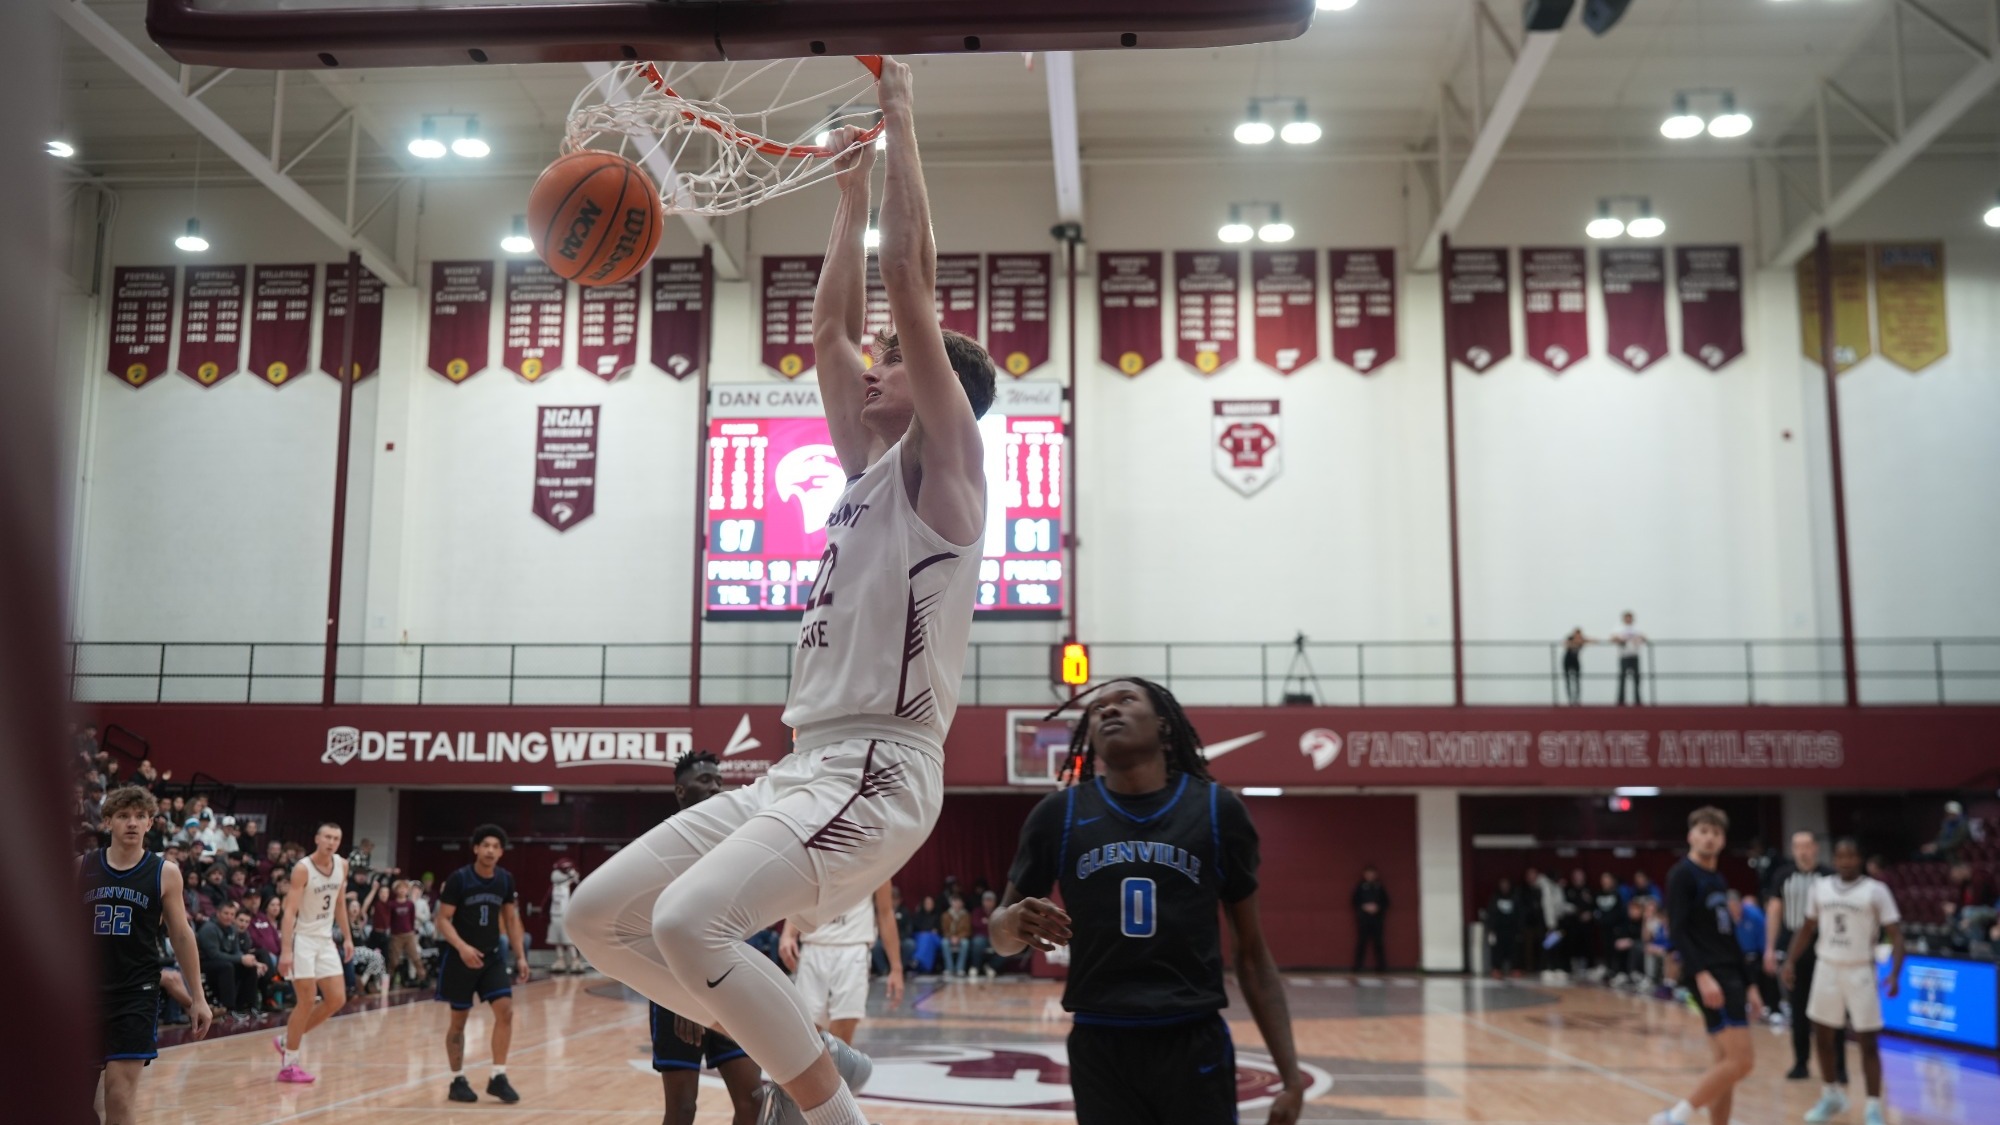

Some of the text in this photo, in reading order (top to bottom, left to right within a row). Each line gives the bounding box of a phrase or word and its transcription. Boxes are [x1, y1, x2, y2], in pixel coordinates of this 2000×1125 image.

[559, 199, 602, 260] NCAA
[719, 390, 818, 407] DAN CAVA
[542, 408, 594, 427] NCAA
[719, 519, 756, 552] 97
[1014, 518, 1051, 552] 81
[360, 731, 692, 763] DETAILING WORLD
[1346, 730, 1845, 768] FAIRMONT STATE ATHLETICS
[1076, 841, 1202, 885] GLENVILLE
[83, 886, 150, 910] GLENVILLE
[322, 895, 331, 910] 3
[1121, 877, 1157, 938] 0
[94, 904, 132, 936] 22
